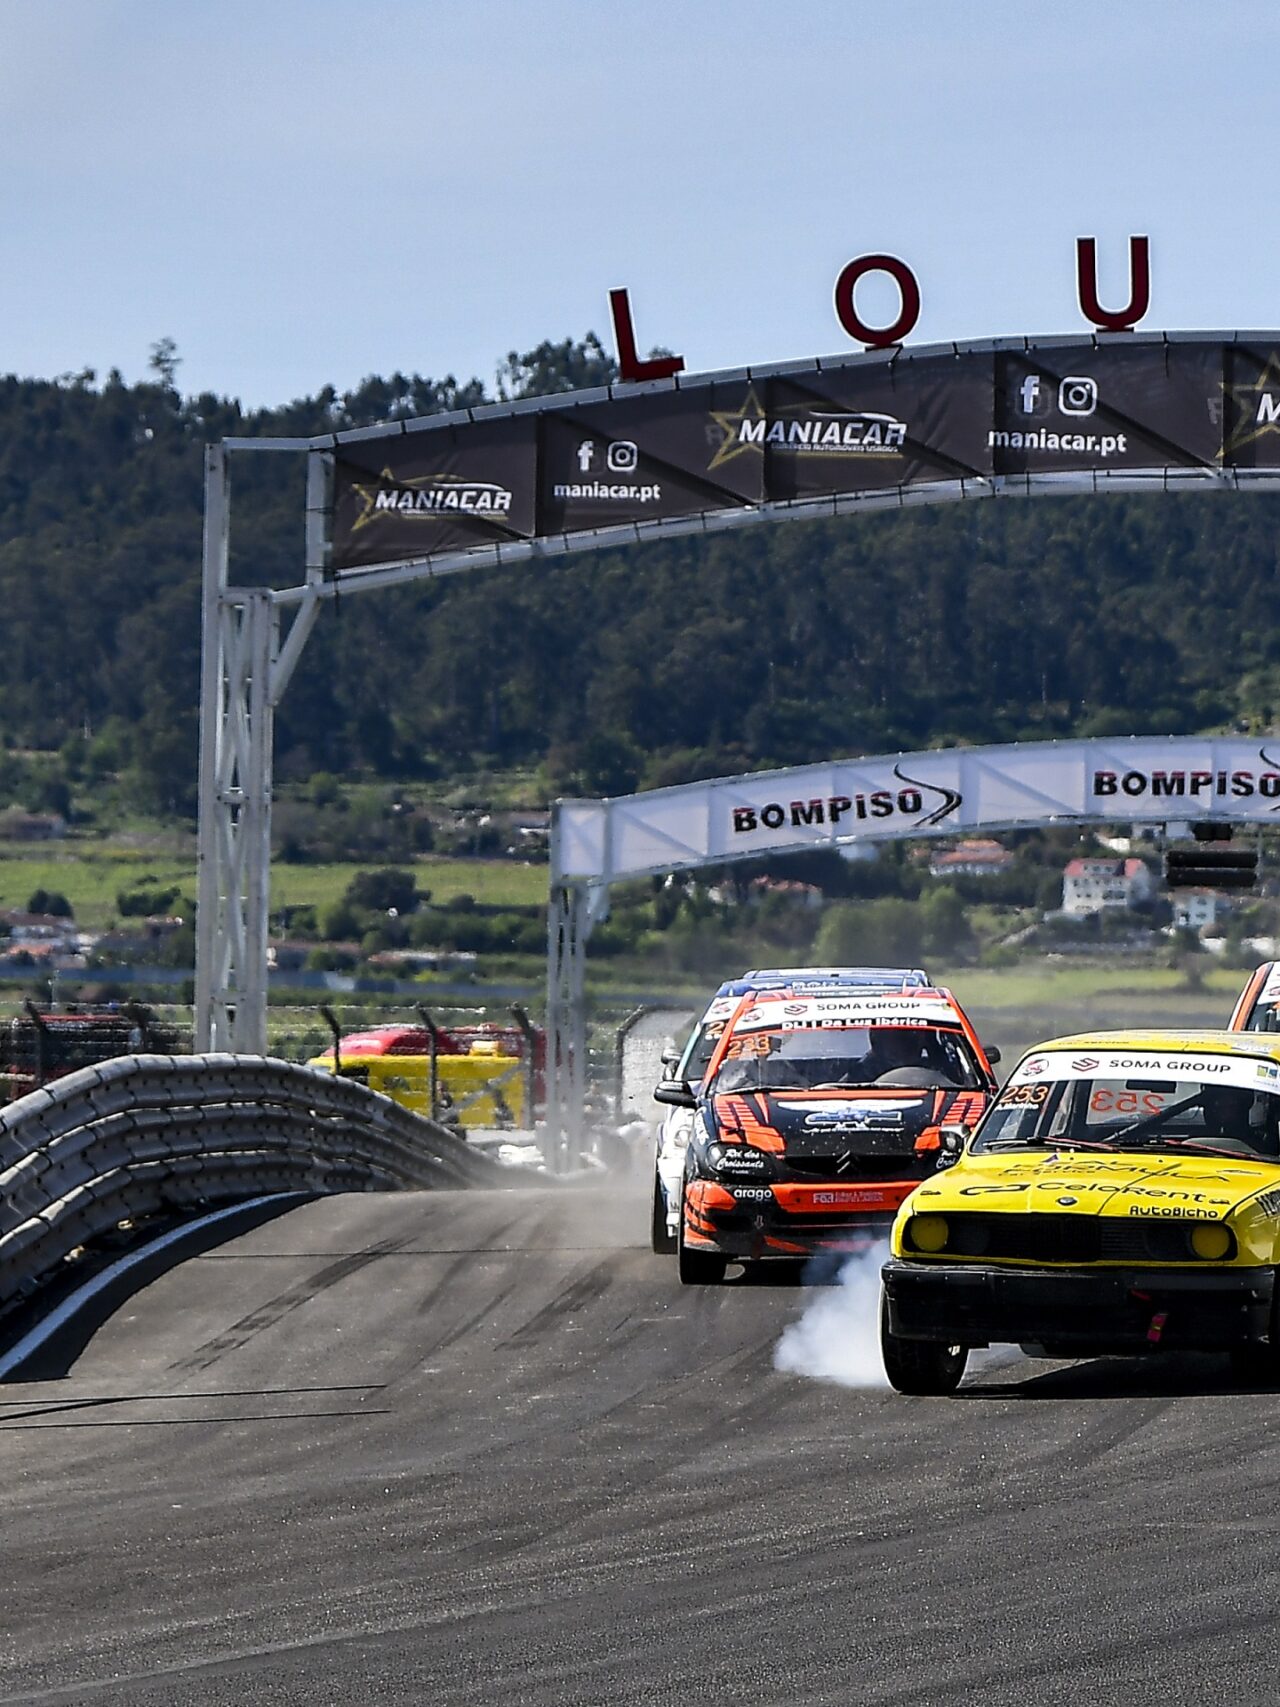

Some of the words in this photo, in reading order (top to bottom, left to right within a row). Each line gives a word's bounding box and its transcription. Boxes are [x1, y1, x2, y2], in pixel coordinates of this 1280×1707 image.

[738, 418, 907, 446] MANIACAR
[988, 428, 1127, 455] maniacar.pt
[375, 489, 512, 511] MANIACAR
[554, 482, 661, 502] maniacar.pt
[732, 787, 923, 833] BOMPISO
[816, 1003, 863, 1012] SOMA
[865, 1001, 921, 1011] GROUP
[1108, 1058, 1161, 1070] SOMA
[1166, 1061, 1231, 1074] GROUP
[999, 1085, 1049, 1104] 253
[716, 1157, 765, 1170] Croissants
[733, 1187, 773, 1201] arago
